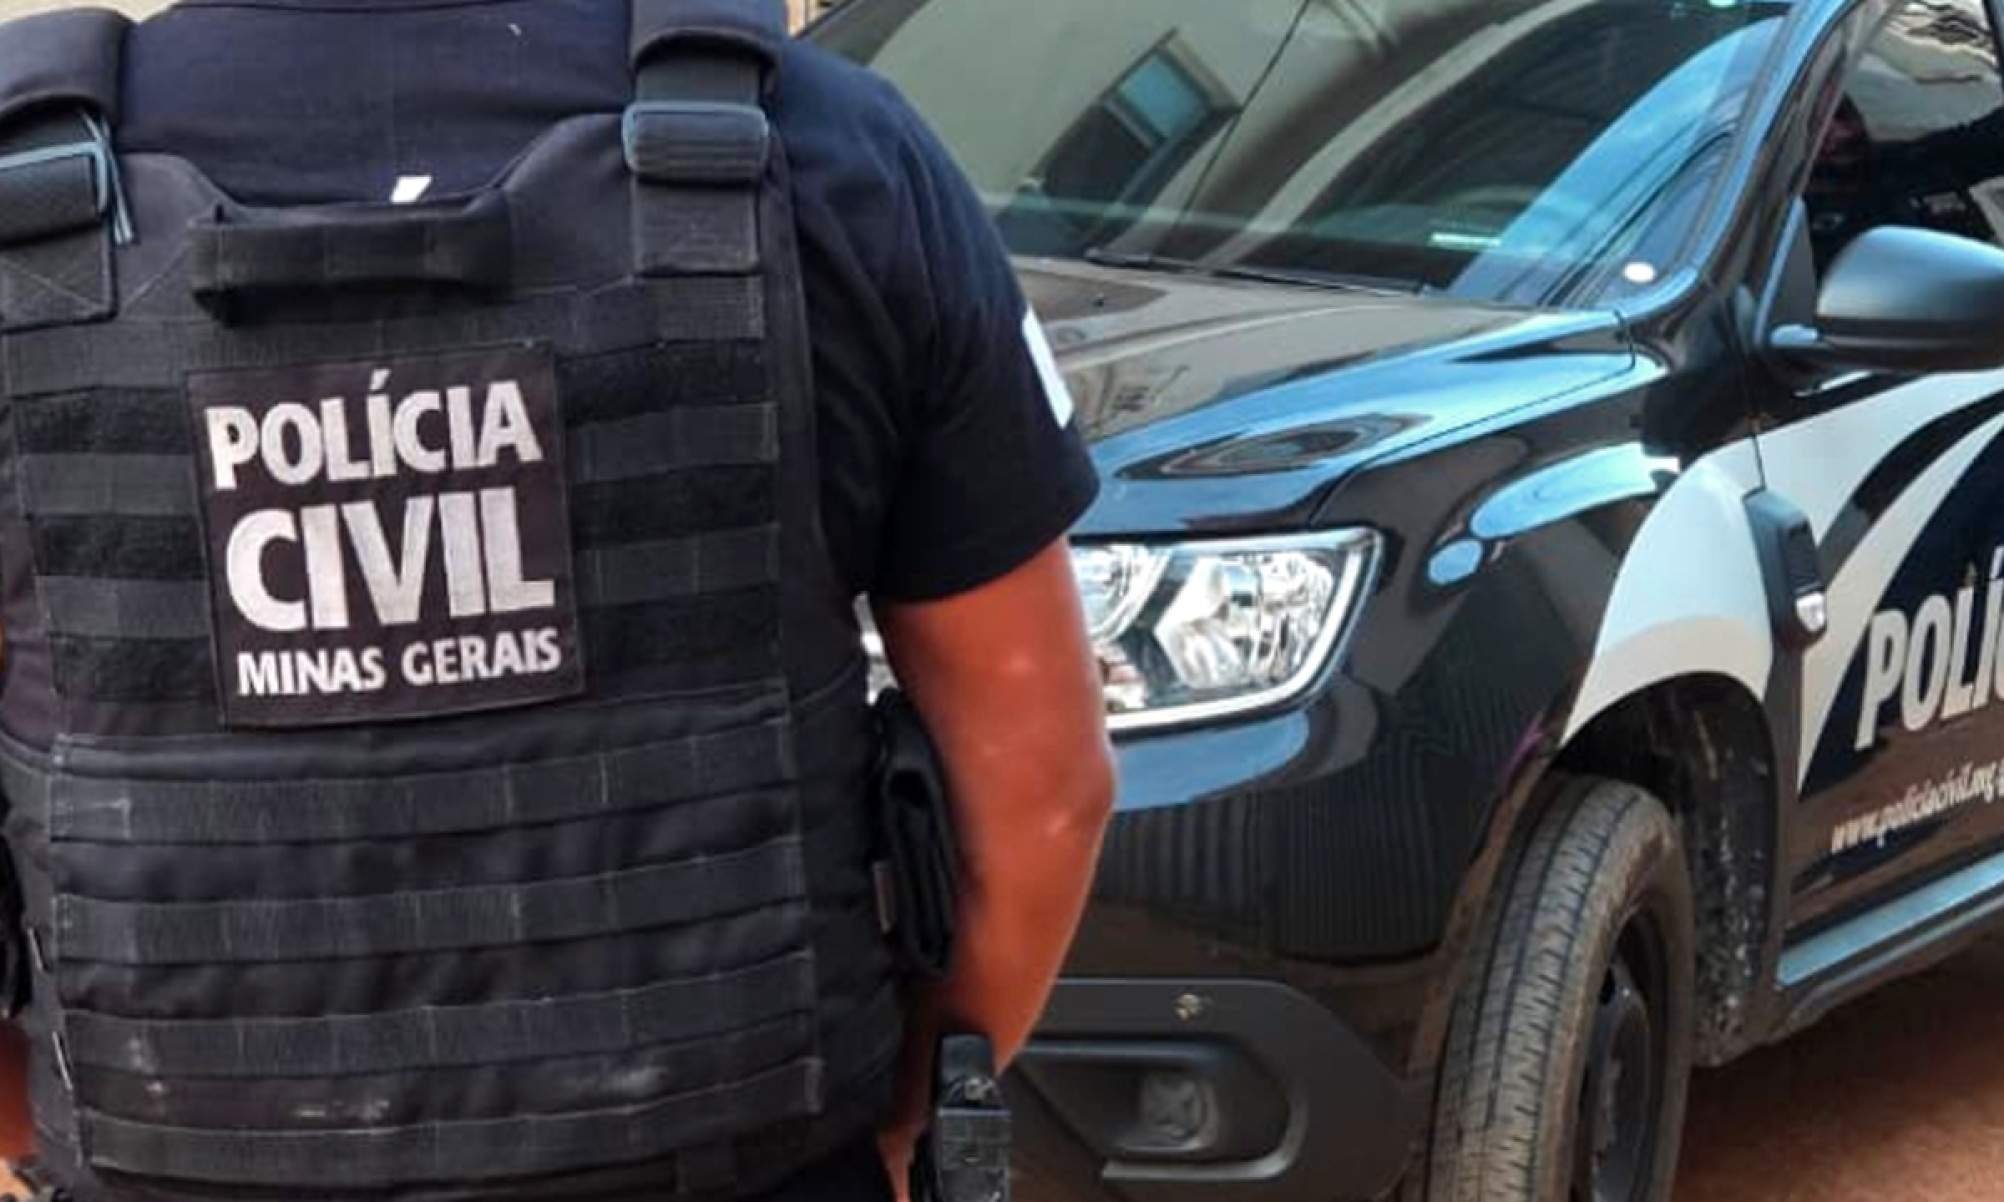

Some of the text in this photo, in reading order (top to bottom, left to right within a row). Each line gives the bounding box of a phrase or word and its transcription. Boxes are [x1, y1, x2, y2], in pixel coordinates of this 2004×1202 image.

[204, 368, 543, 489] POLÍCIA
[226, 486, 555, 631] CIVIL
[237, 627, 562, 695] MINAS GERAIS
